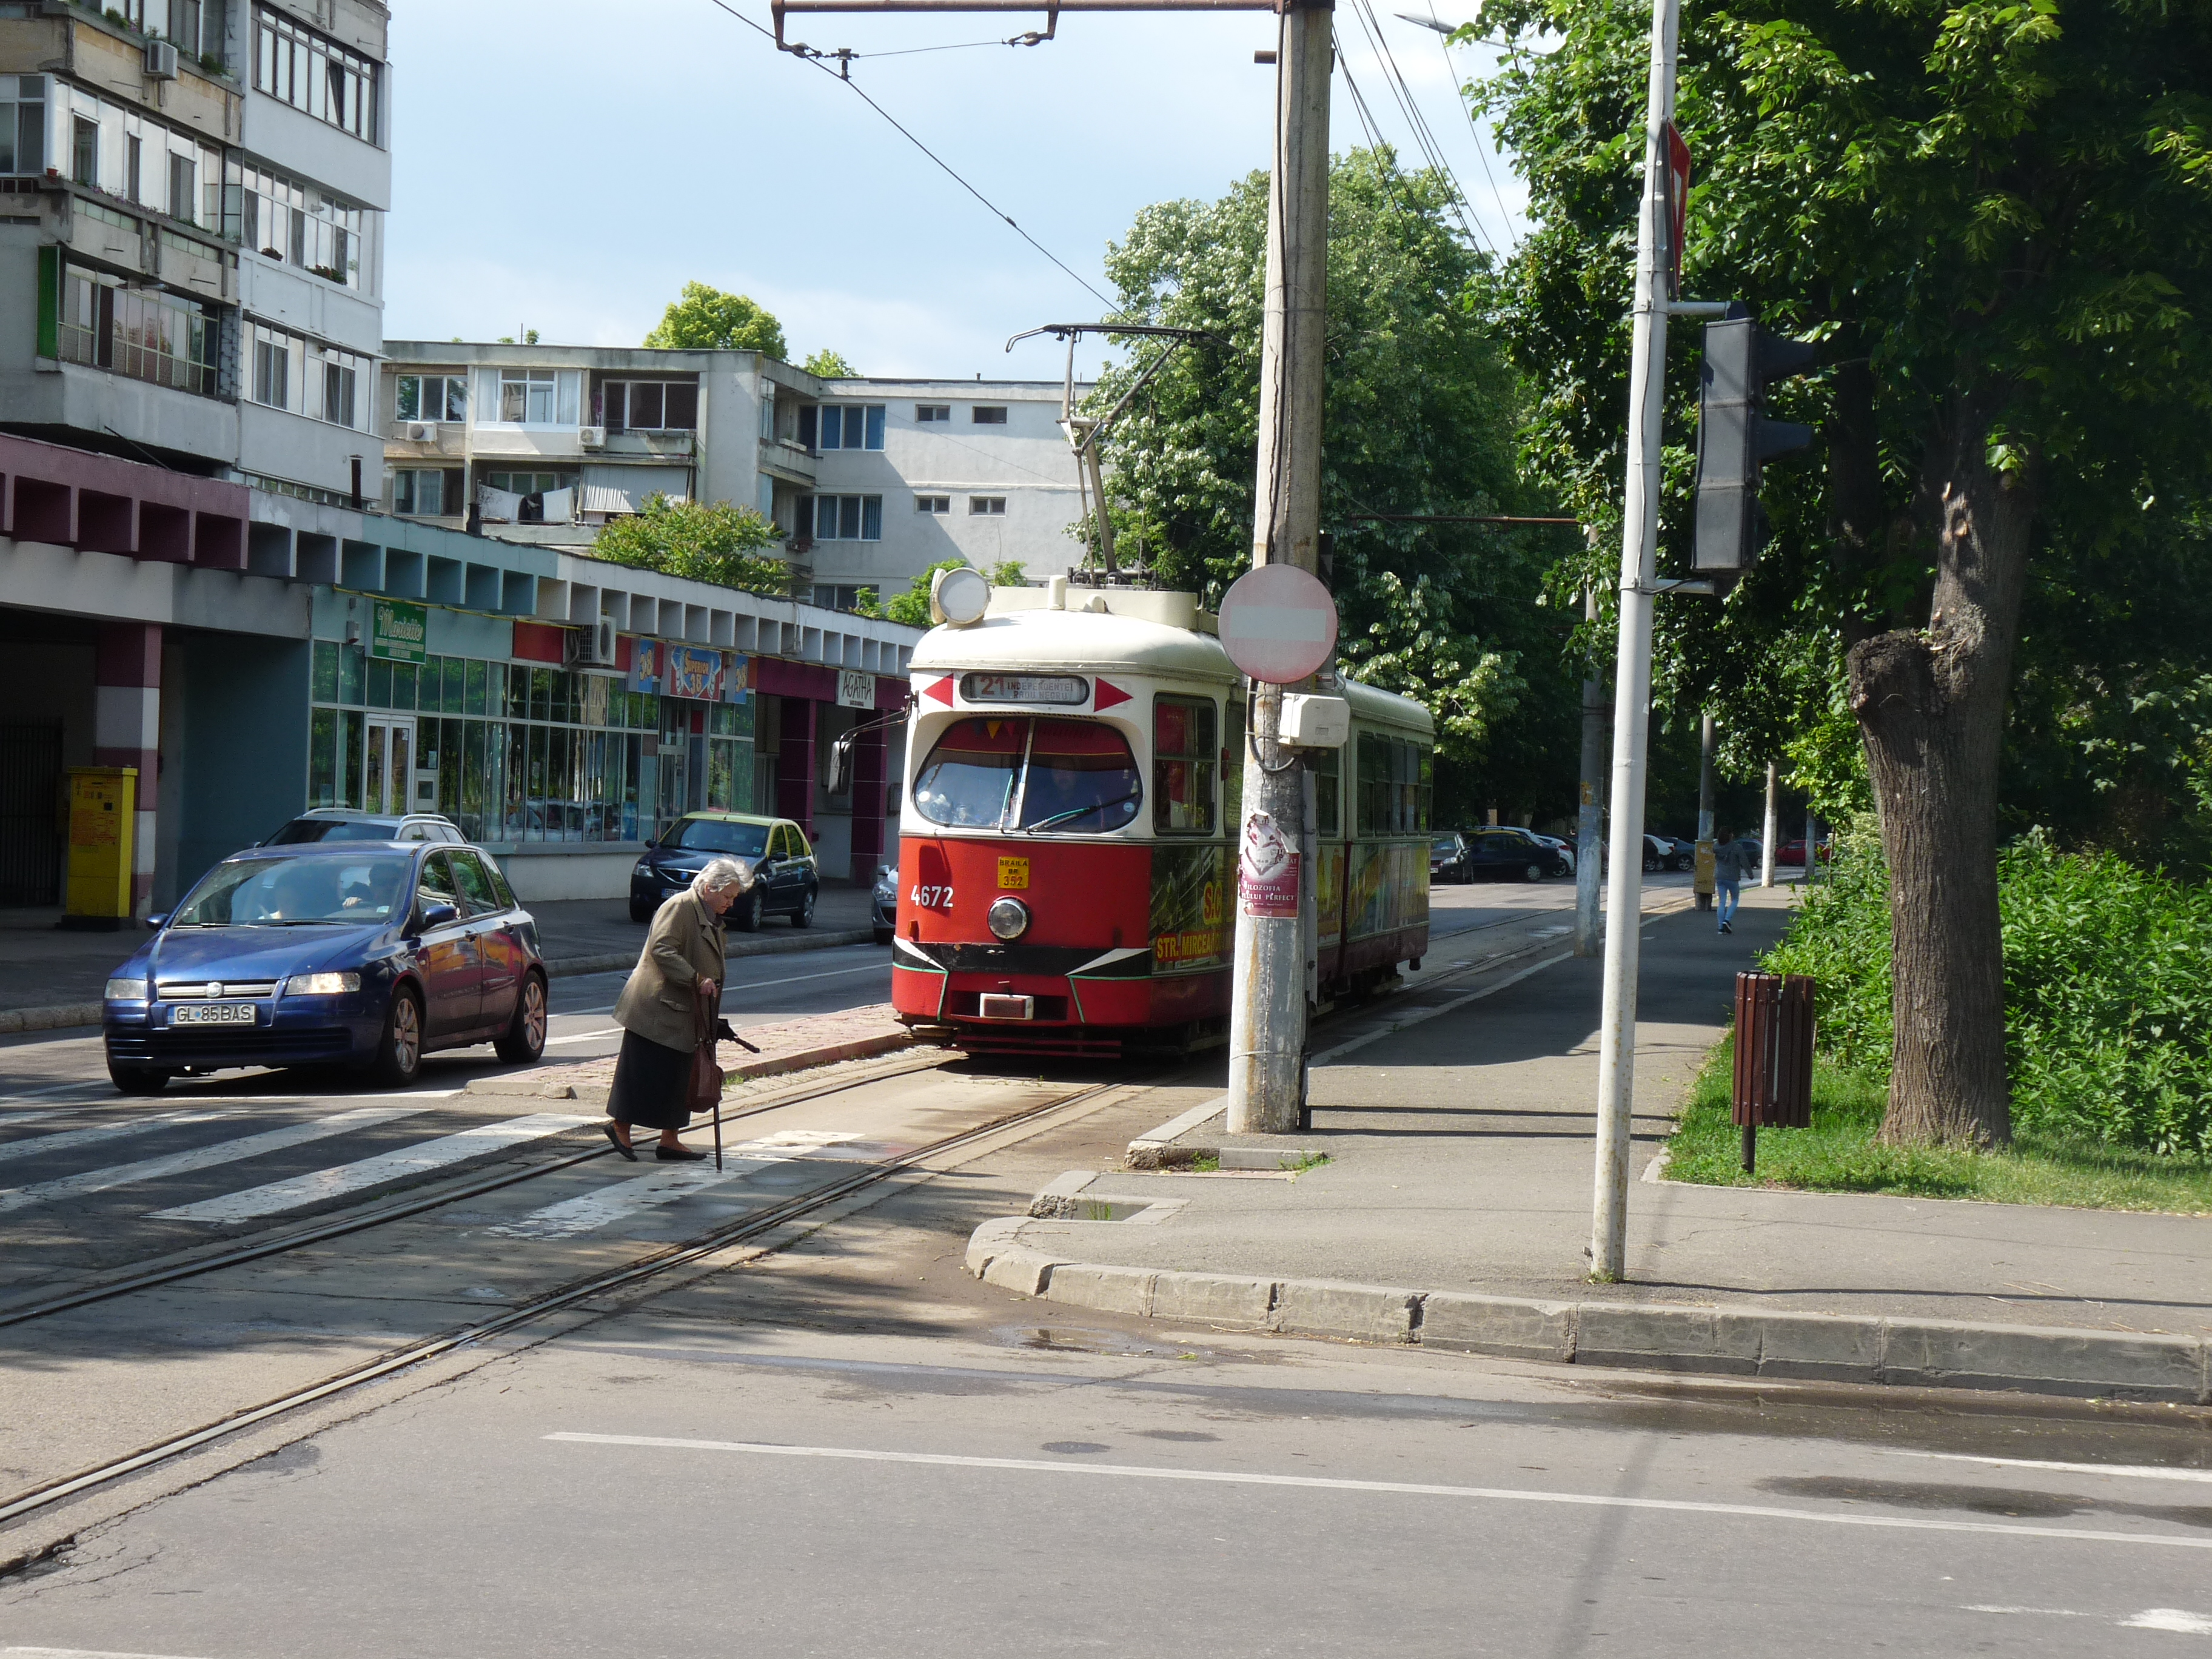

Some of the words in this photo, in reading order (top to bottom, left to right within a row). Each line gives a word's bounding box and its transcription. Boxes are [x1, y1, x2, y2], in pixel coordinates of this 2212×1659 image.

[639, 648, 653, 681] 38
[690, 674, 702, 694] 38
[736, 663, 747, 692] 38
[842, 674, 872, 700] AGATHA
[980, 677, 1005, 696] 21
[1013, 691, 1036, 700] RADU
[1039, 691, 1067, 700] NEGRU
[1004, 876, 1023, 886] 352
[910, 885, 954, 908] 4672
[1157, 936, 1179, 959] STR.
[176, 1007, 195, 1022] GL
